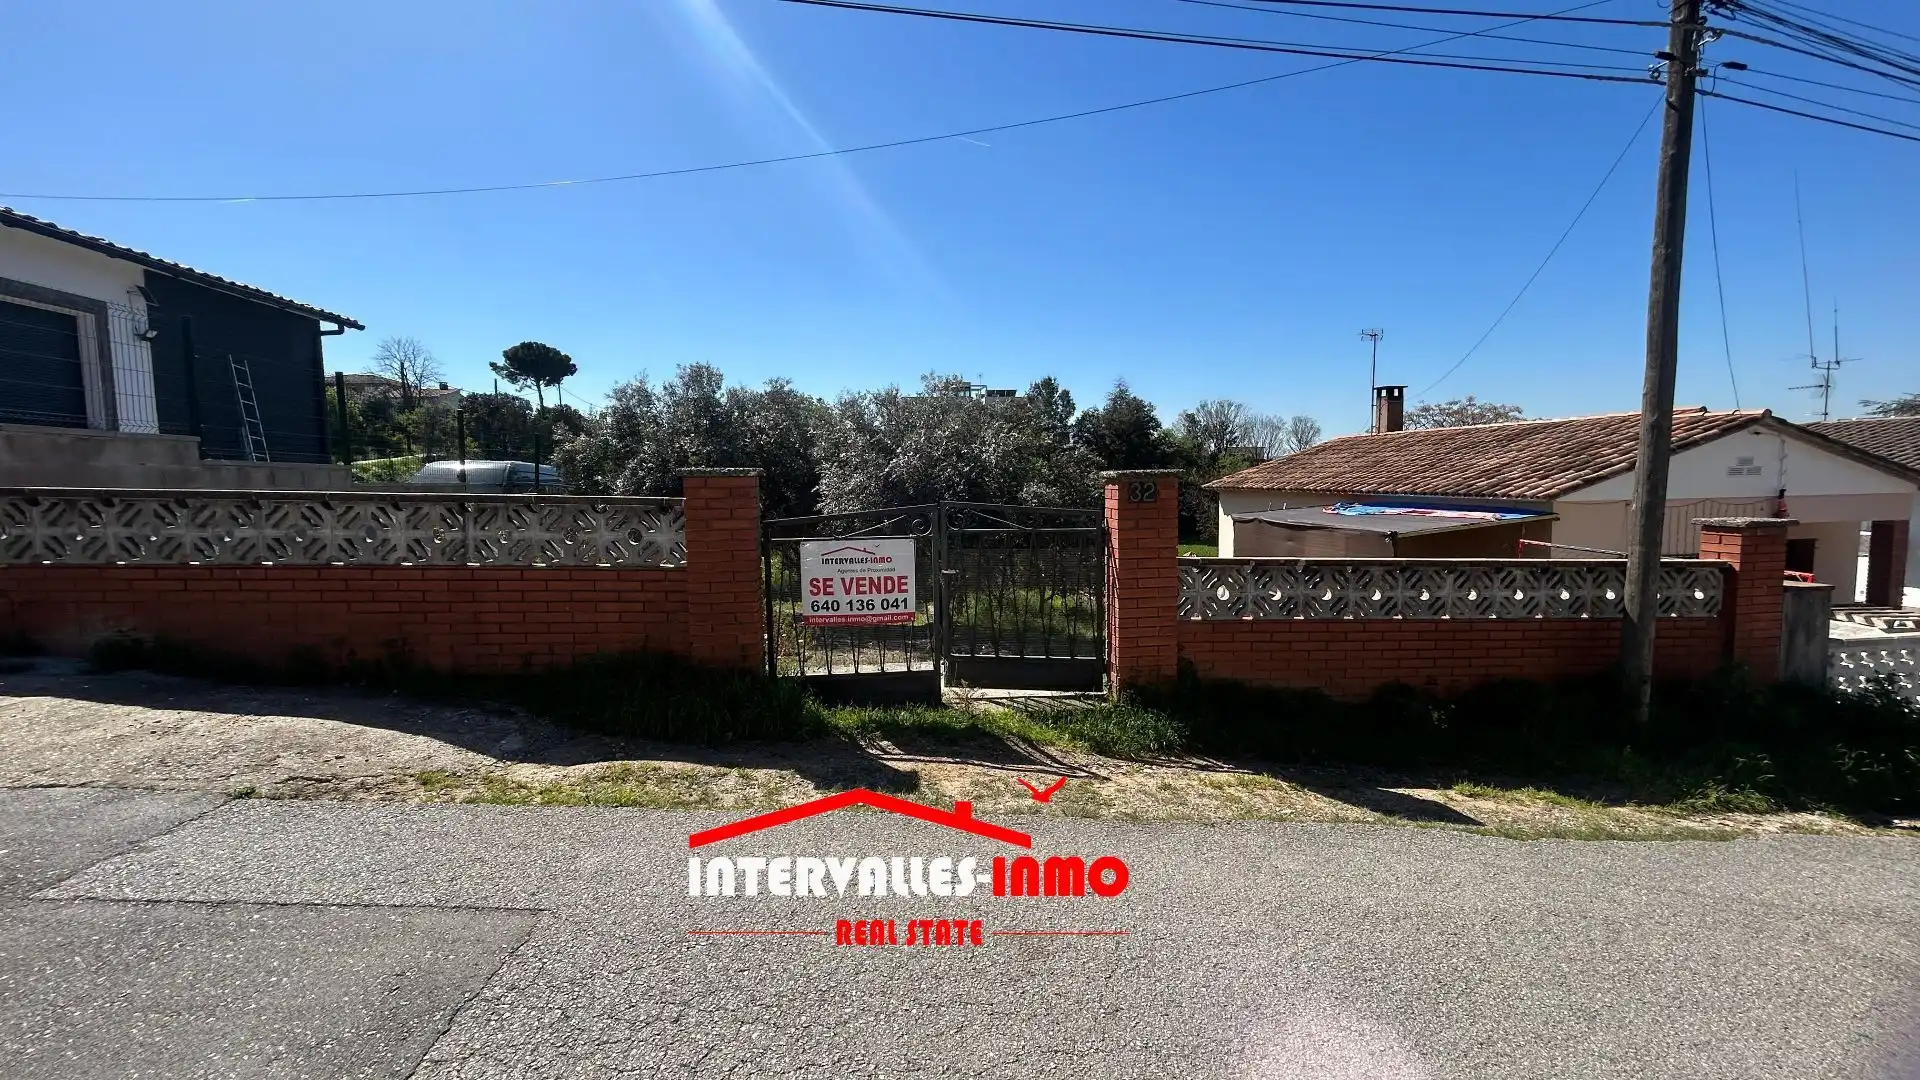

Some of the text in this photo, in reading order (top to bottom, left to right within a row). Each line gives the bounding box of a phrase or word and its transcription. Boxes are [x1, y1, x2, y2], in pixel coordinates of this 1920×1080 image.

[1130, 482, 1155, 501] 32
[821, 556, 893, 565] INTERVALLES-INMO
[809, 575, 909, 597] SE VENDE
[810, 597, 909, 612] 640 136 041
[809, 614, 909, 624] intervalles.inmo@gmail.com
